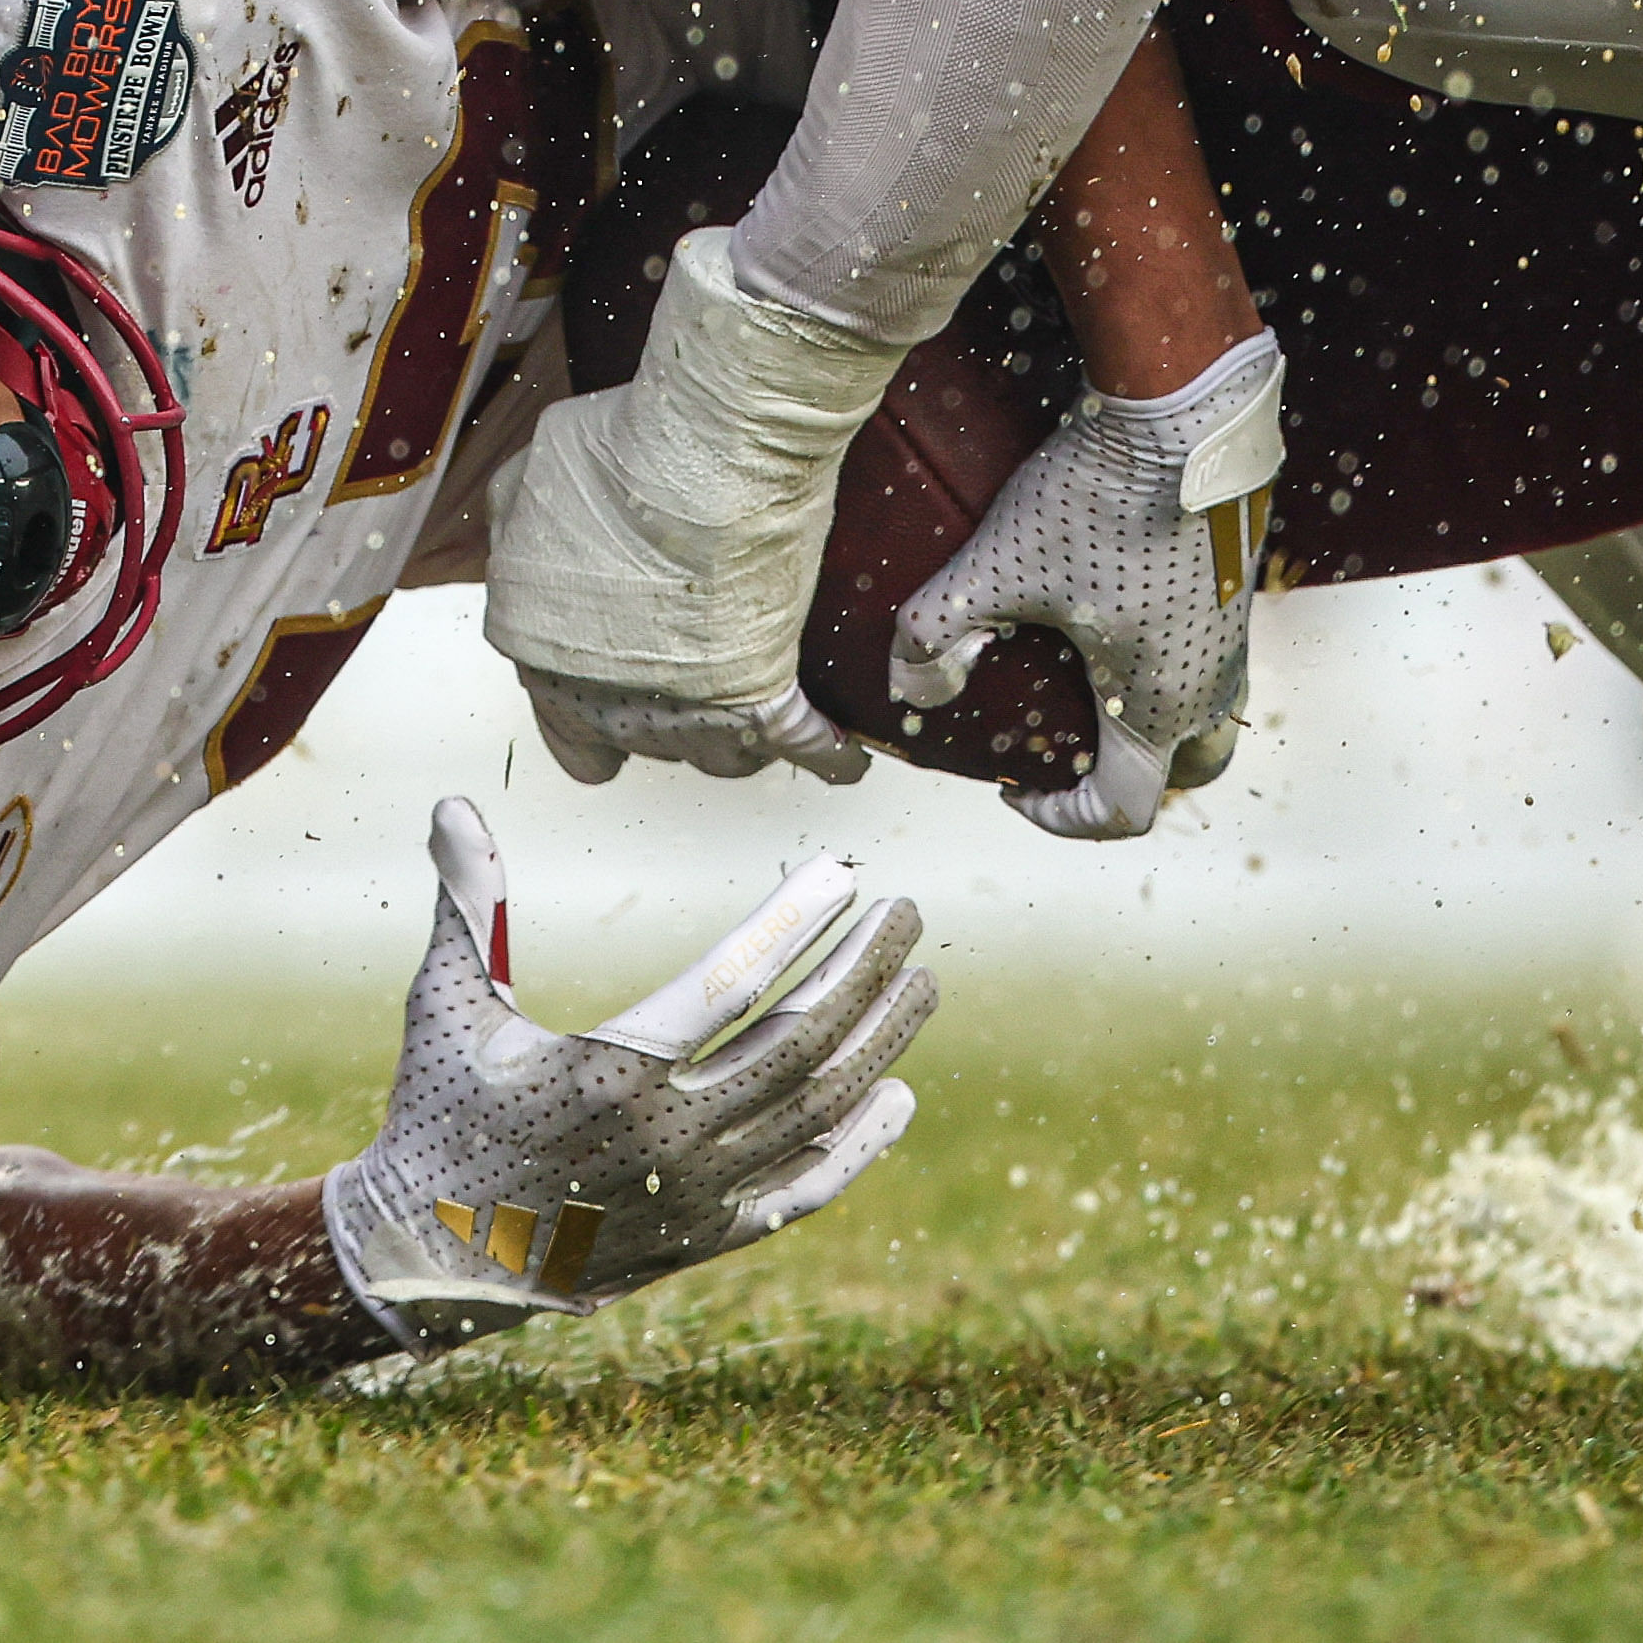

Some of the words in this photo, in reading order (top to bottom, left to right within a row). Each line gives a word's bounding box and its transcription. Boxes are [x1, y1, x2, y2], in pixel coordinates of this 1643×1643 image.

[35, 91, 78, 173] BAD
[107, 75, 146, 175] PINSTRIPE
[131, 4, 169, 69] BOWL
[141, 100, 161, 145] YANKEE
[153, 41, 174, 95] STADIUM
[244, 41, 300, 208] adidas
[703, 901, 803, 1007] ADIZERO
